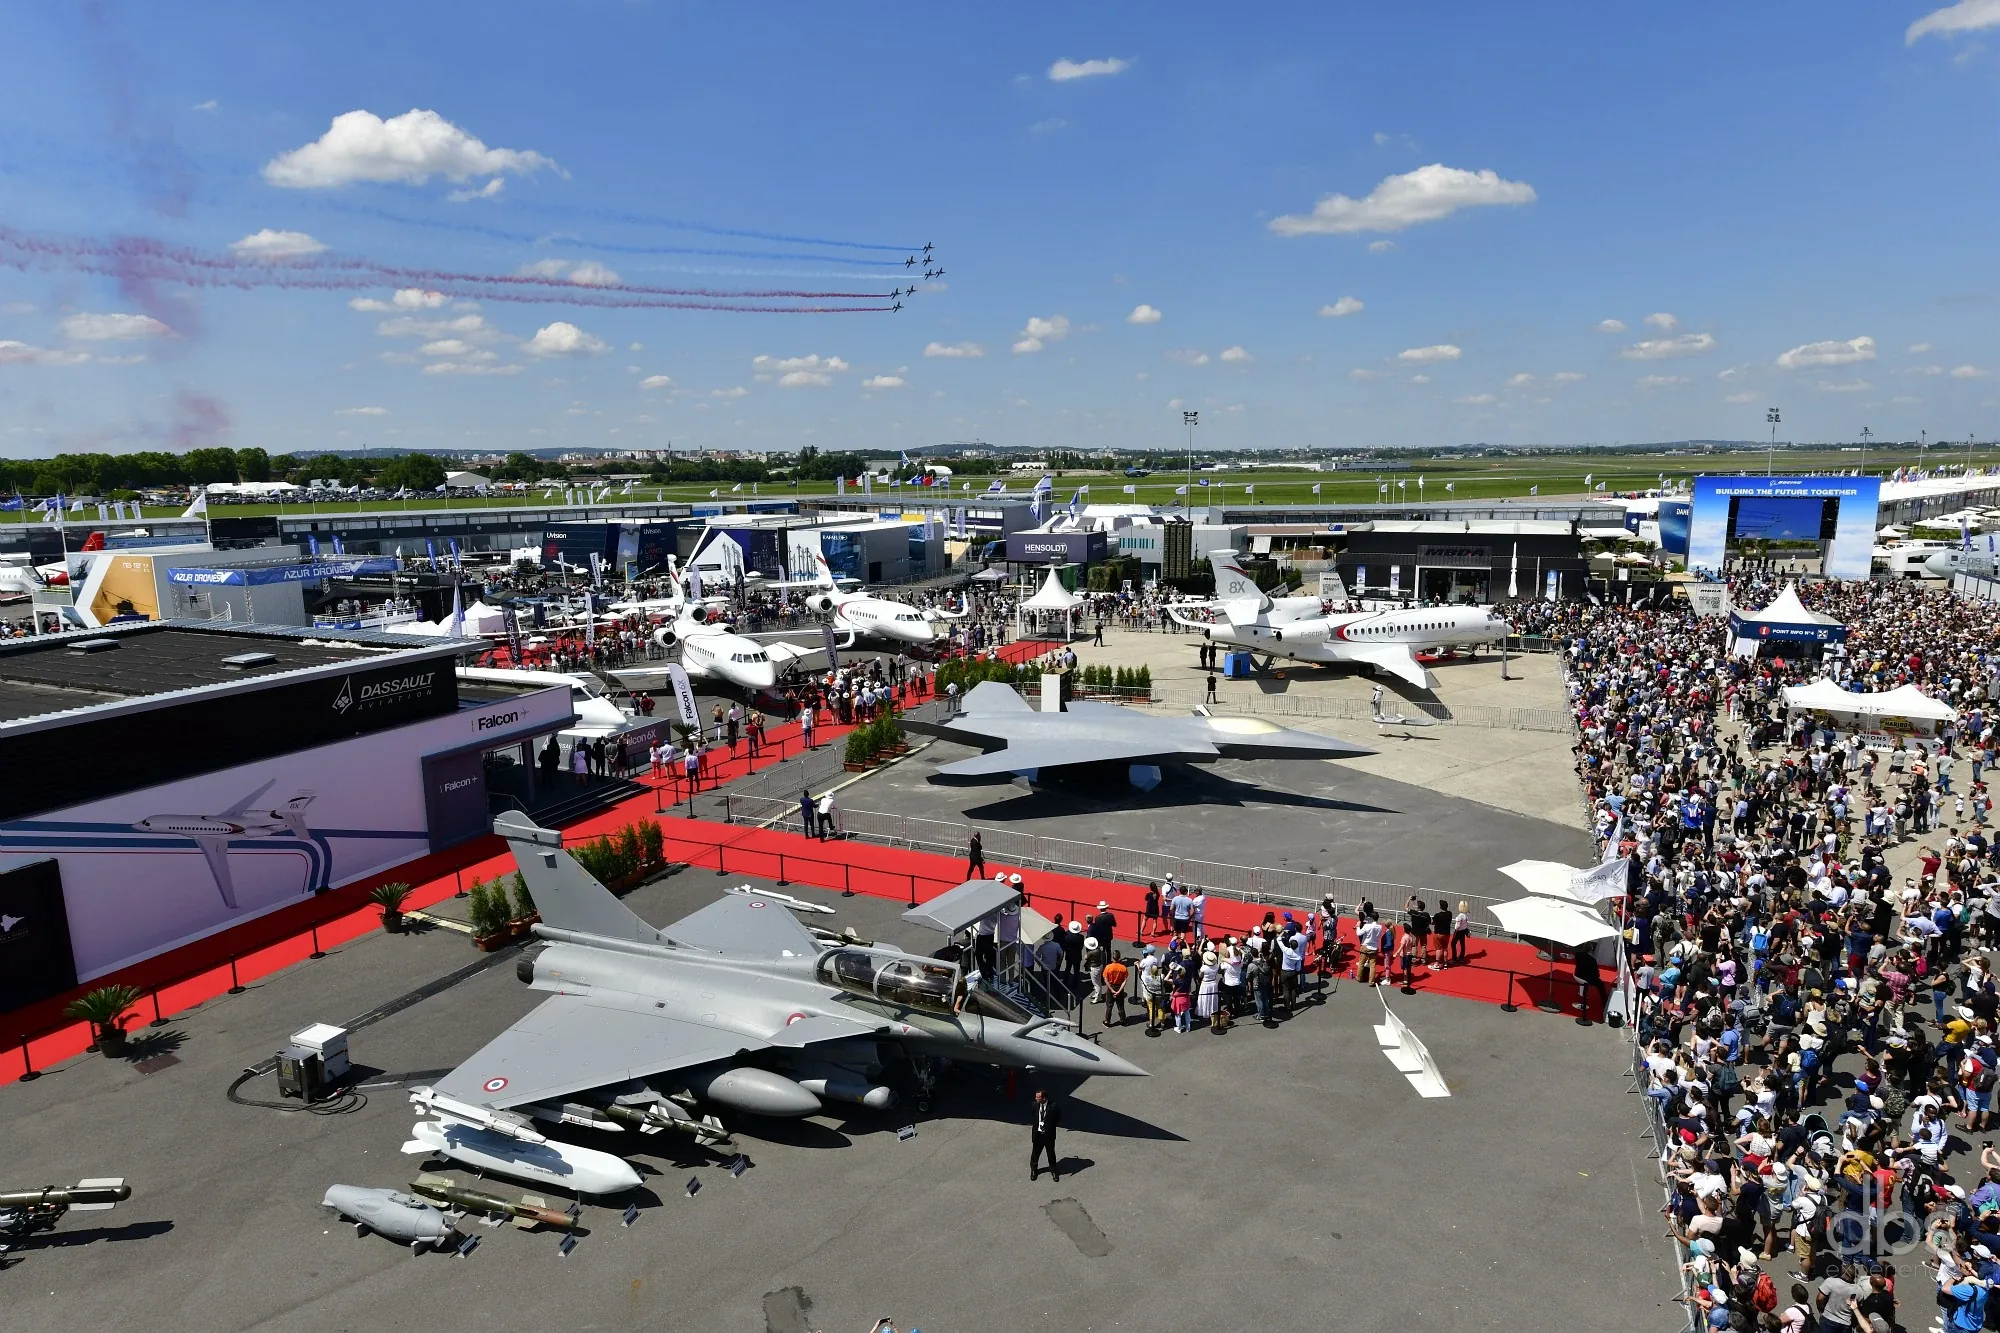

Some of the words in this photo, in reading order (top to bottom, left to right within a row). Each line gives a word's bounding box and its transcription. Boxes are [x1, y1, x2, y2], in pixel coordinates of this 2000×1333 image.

[1024, 543, 1065, 552] HENSOLDT
[173, 573, 193, 582] AZUR
[194, 573, 221, 582] DRONES
[283, 568, 310, 579] AZUR
[313, 565, 351, 576] DRONES
[1228, 580, 1246, 594] 8X
[360, 672, 436, 699] DASSAULT
[677, 679, 686, 690] 6X
[358, 689, 433, 711] AVIATION
[681, 691, 693, 720] Falcon
[477, 711, 519, 731] Falcon
[647, 729, 657, 740] 6X
[444, 778, 471, 792] Falcon
